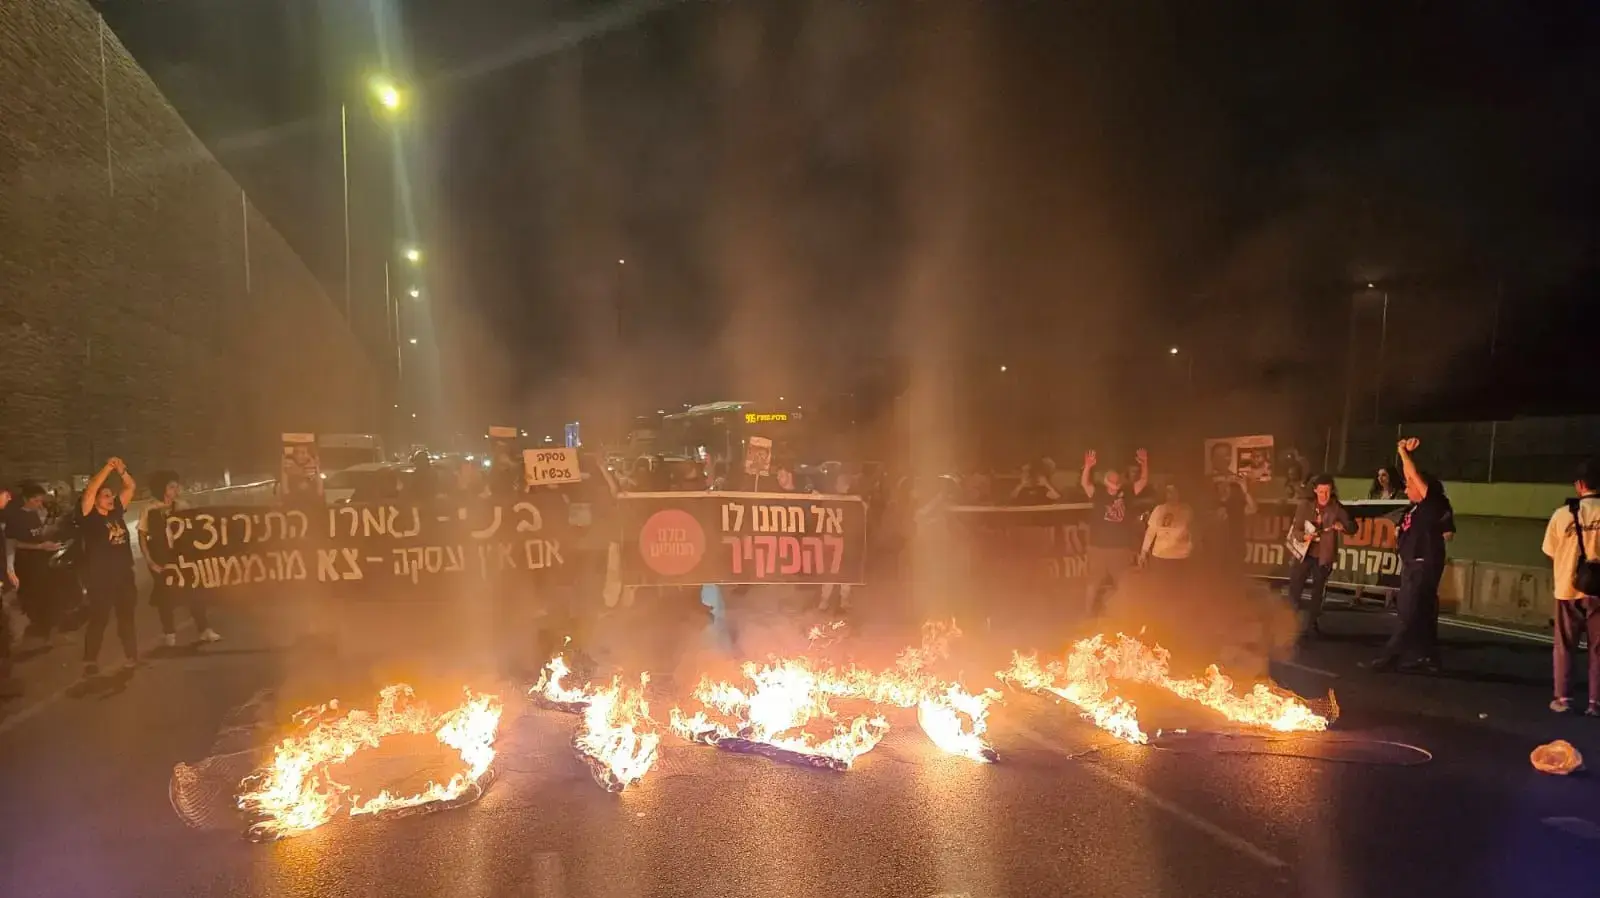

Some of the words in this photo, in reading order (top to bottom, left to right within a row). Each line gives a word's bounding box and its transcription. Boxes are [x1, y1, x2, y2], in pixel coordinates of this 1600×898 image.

[537, 452, 567, 464] עסקה
[165, 510, 308, 550] התירוצים
[328, 504, 421, 539] נגמרו
[721, 502, 745, 533] לו
[752, 504, 806, 534] תתנו
[811, 503, 844, 534] אל
[163, 549, 307, 588] מהממשלה
[318, 547, 364, 583] צא
[392, 545, 465, 585] עסקה
[525, 539, 564, 569] אם
[722, 535, 844, 578] להפקיר
